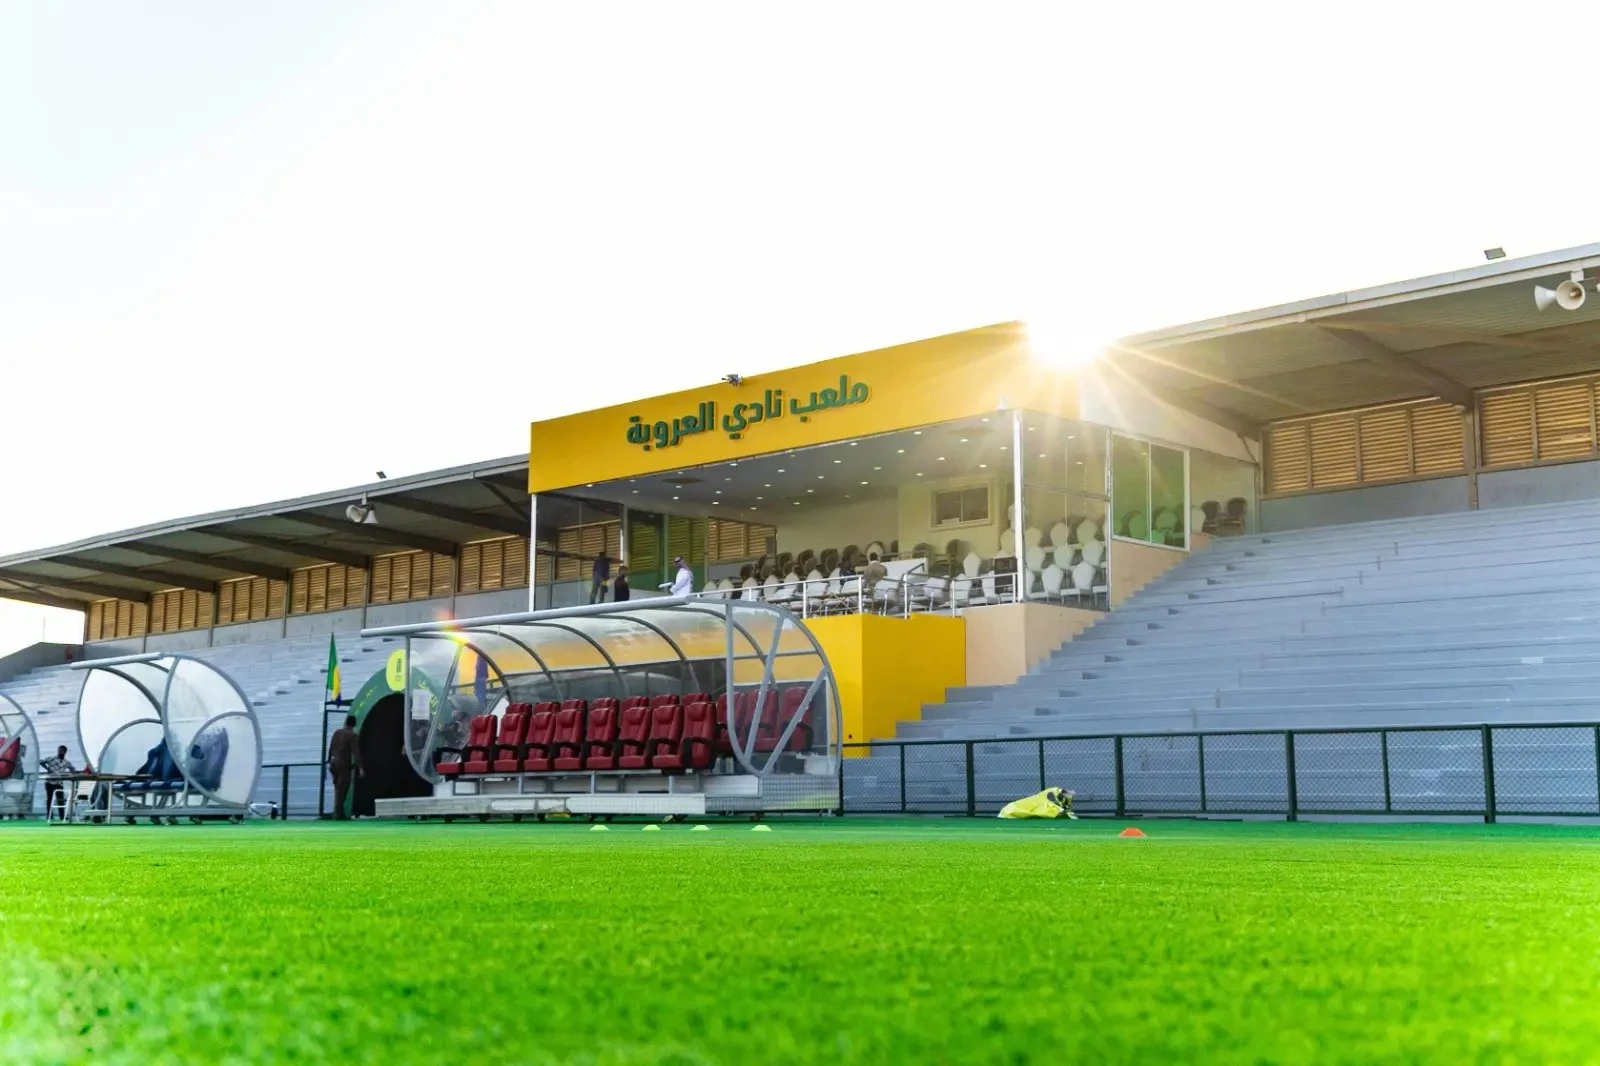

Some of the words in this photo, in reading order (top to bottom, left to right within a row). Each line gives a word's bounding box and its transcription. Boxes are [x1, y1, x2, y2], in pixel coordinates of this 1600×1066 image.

[722, 389, 783, 440] نادي
[790, 375, 869, 422] ملعب
[626, 401, 715, 451] العروبة
